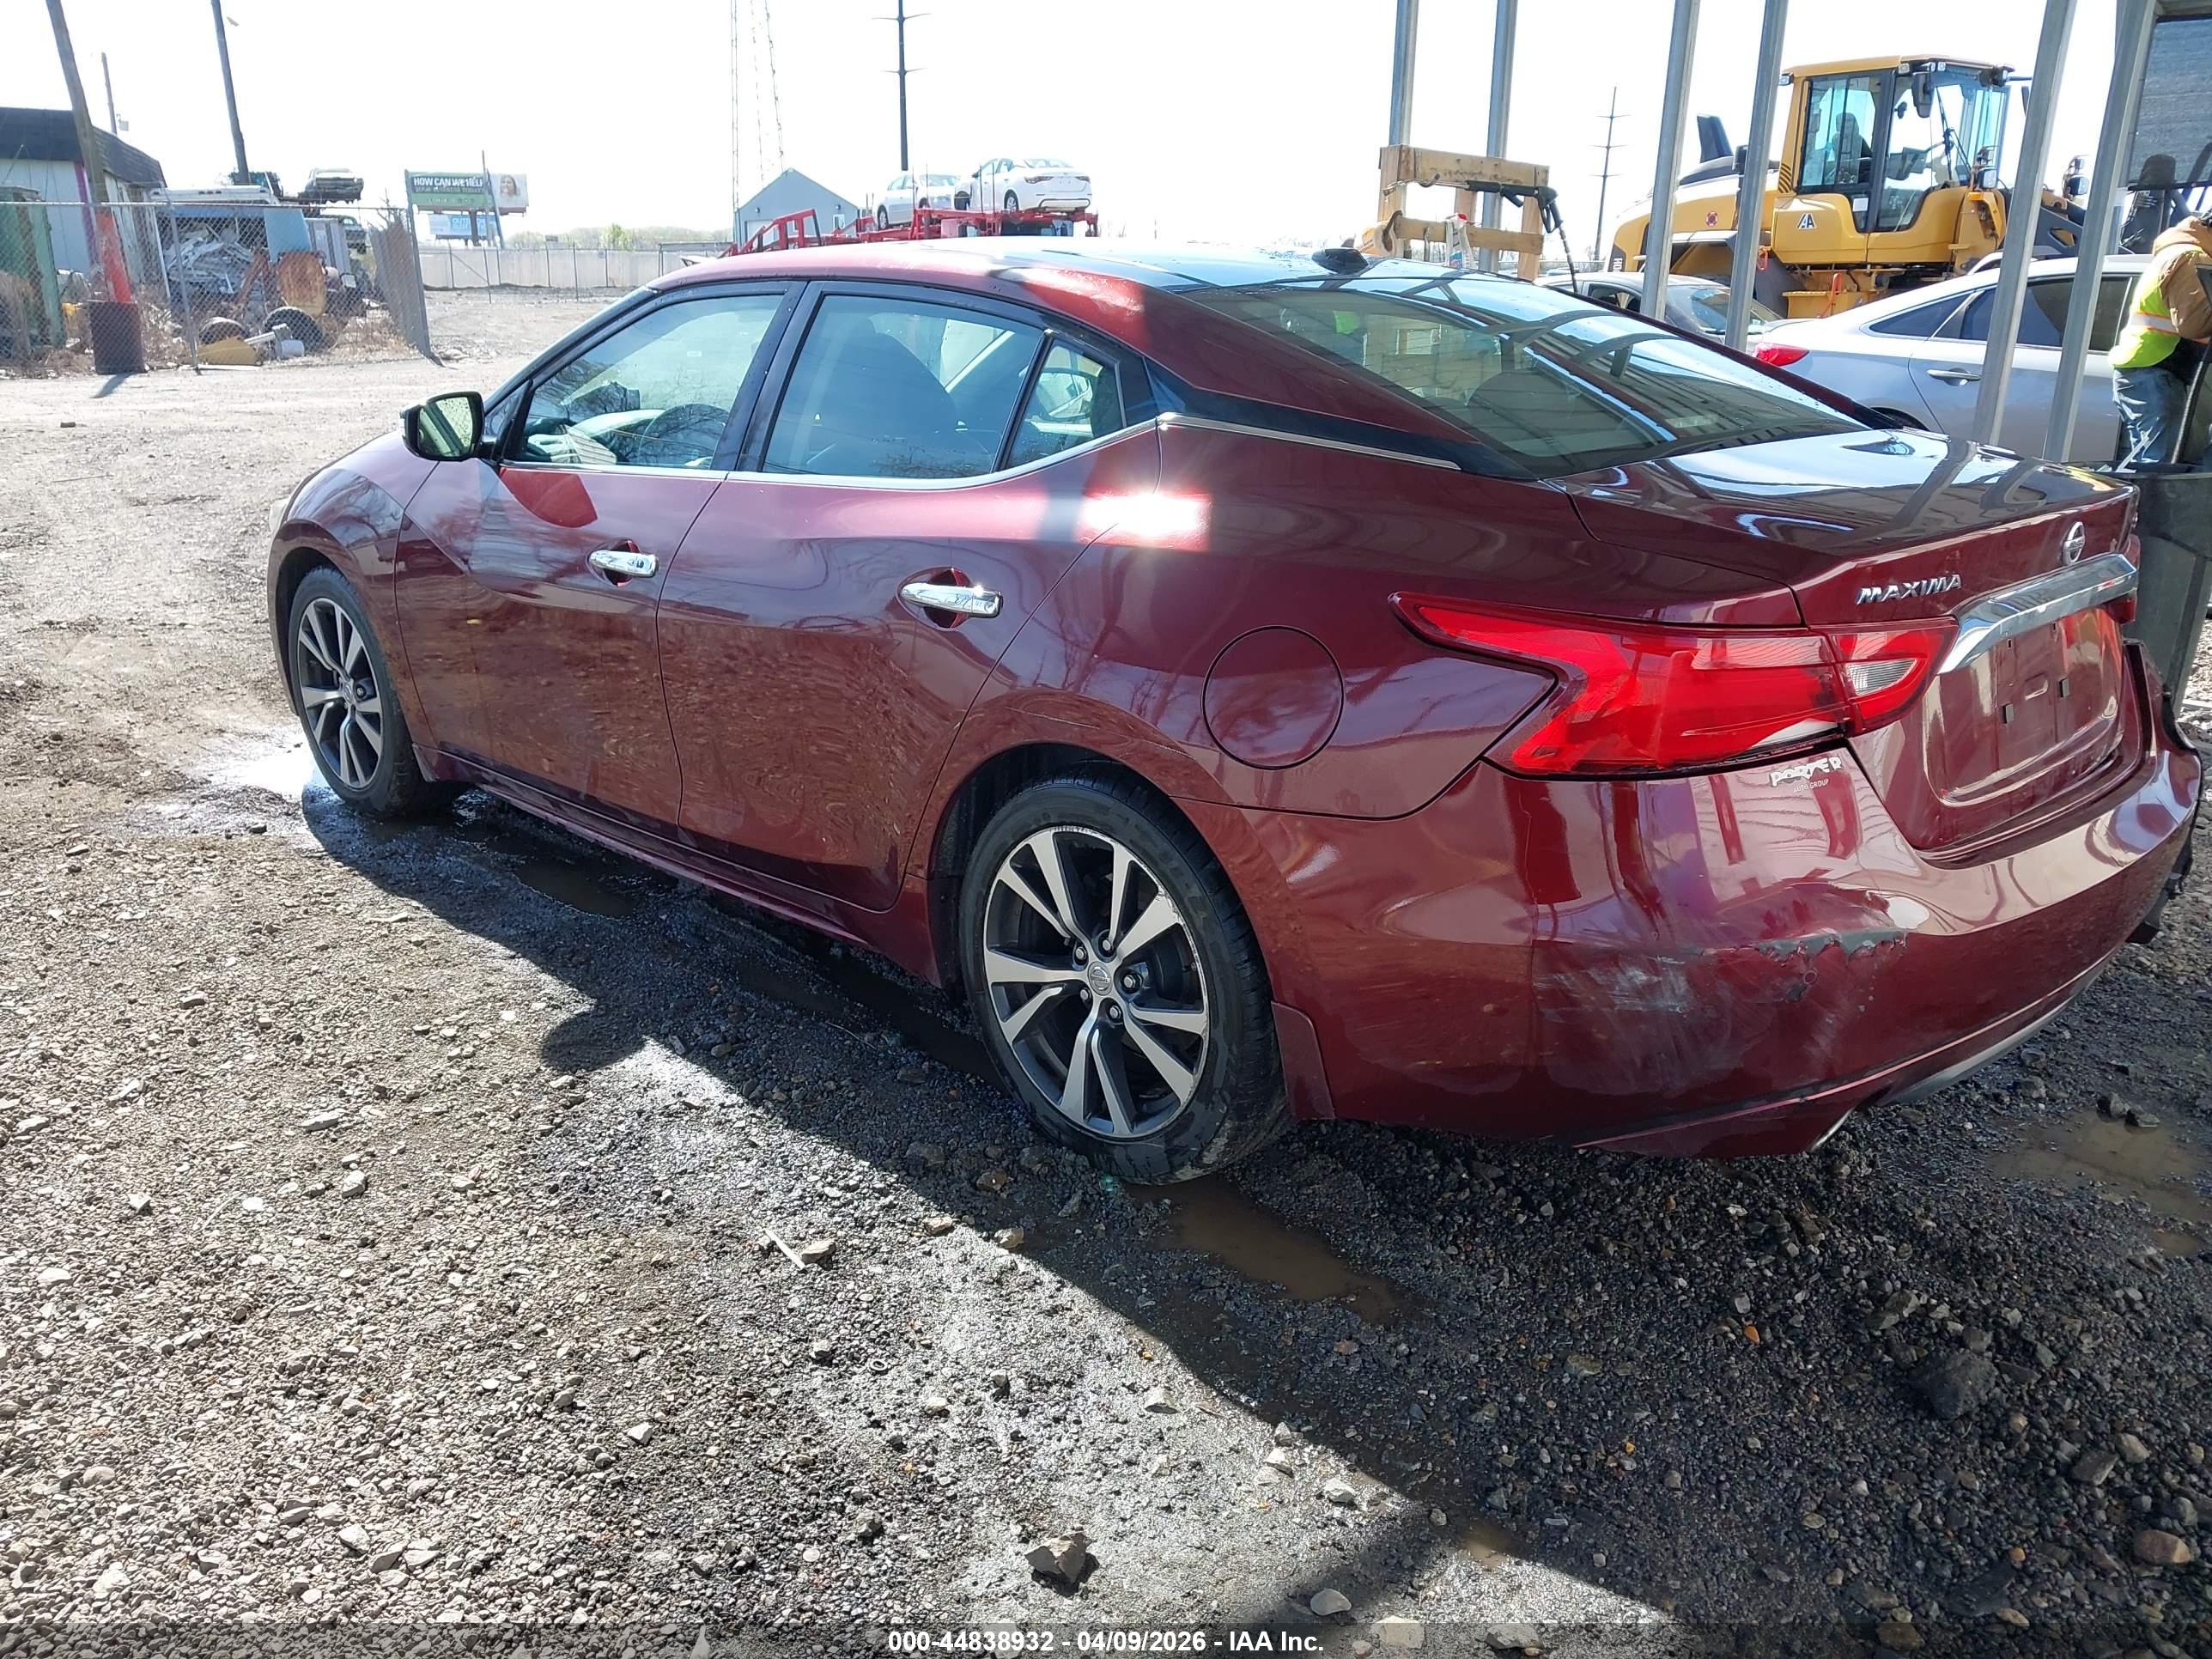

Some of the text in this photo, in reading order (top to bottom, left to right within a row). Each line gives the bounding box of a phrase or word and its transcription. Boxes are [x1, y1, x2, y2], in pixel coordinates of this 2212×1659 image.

[414, 177, 433, 186] HOW
[434, 178, 451, 186] CAN
[1856, 574, 1962, 605] MAXIMA
[1770, 757, 1841, 787] PORTER
[1794, 779, 1829, 793] AUTO GROUP
